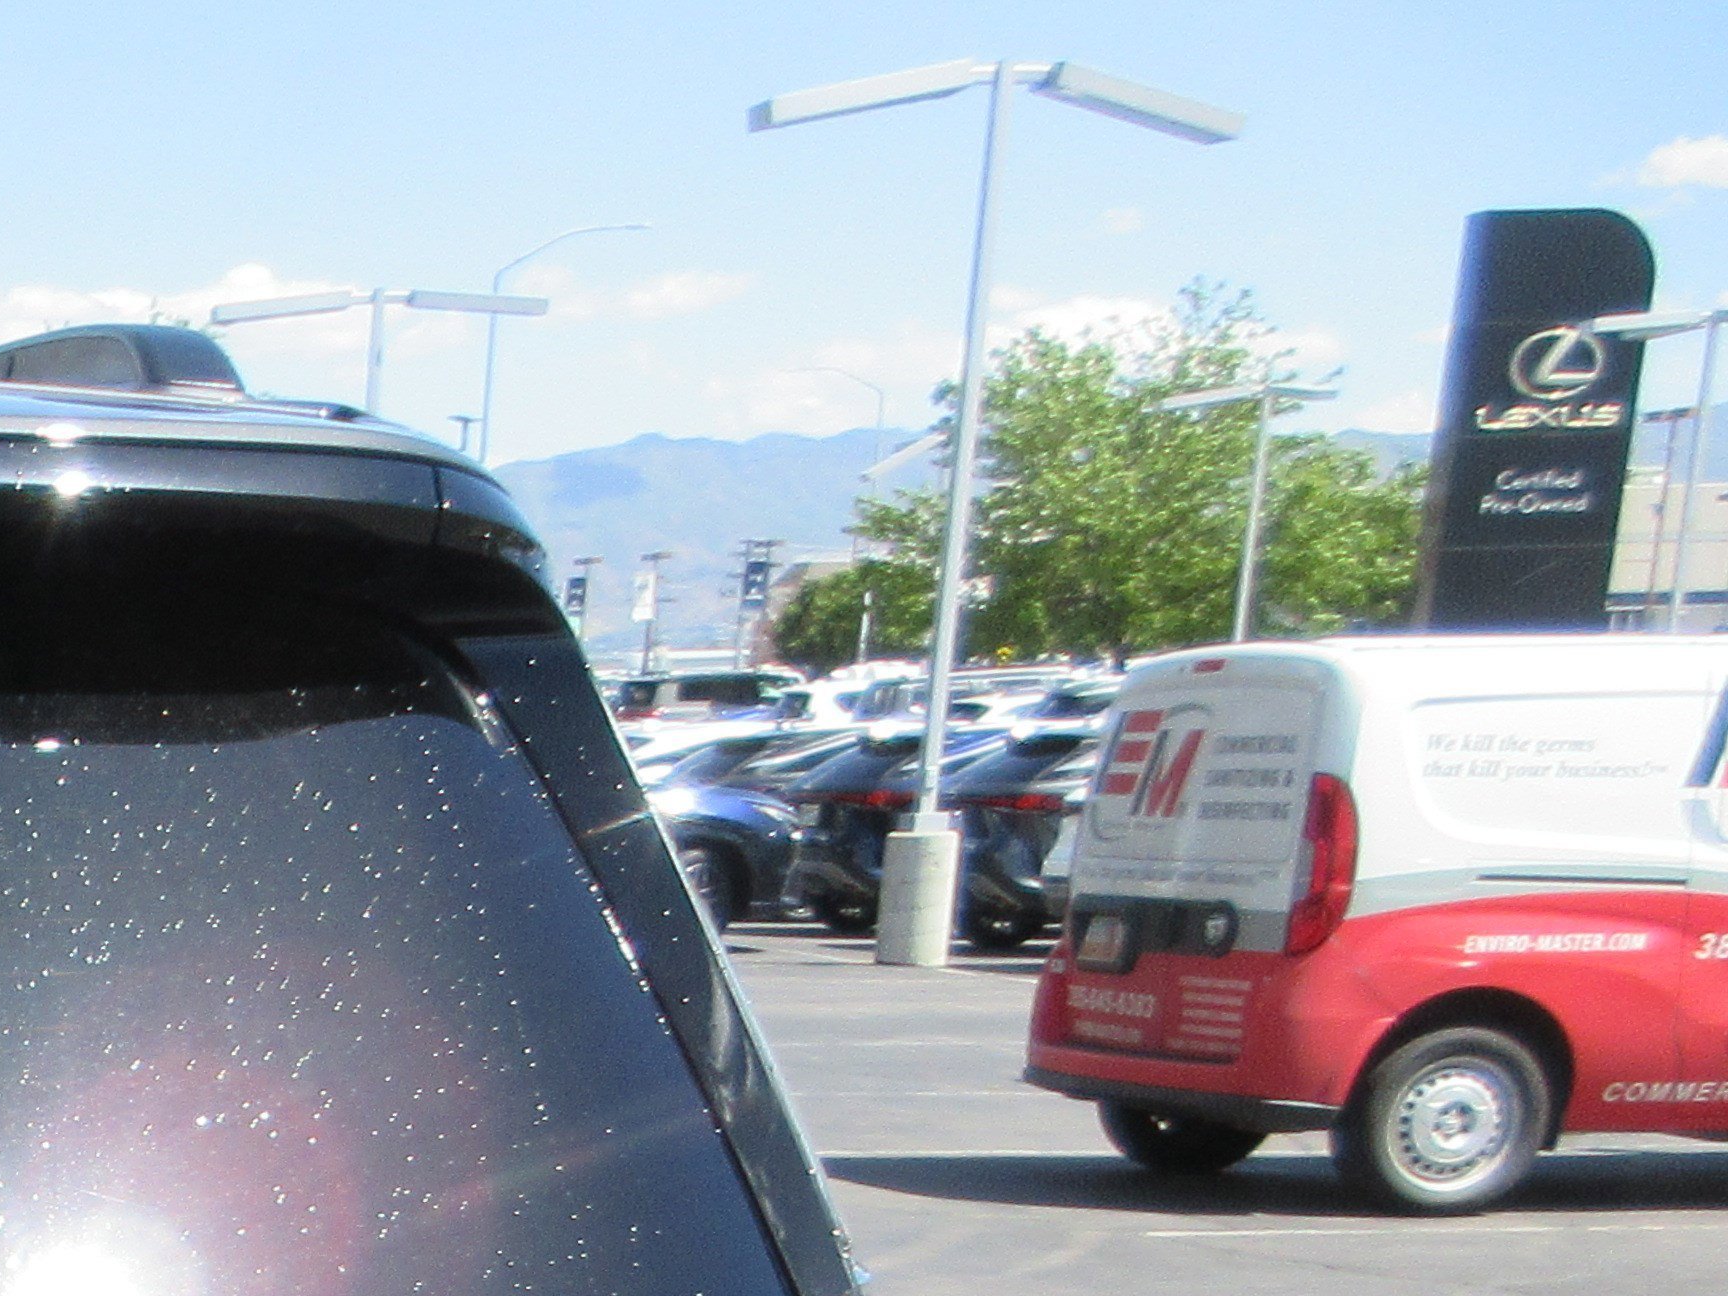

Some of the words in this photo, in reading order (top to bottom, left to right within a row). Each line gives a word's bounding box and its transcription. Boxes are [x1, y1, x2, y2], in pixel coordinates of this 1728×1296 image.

[1474, 403, 1624, 430] LEXUS
[1426, 734, 1452, 752] We
[1460, 733, 1496, 752] kill
[1499, 735, 1530, 752] the
[1535, 738, 1597, 757] germs
[1422, 761, 1463, 777] that
[1467, 760, 1502, 778] kill
[1504, 765, 1551, 782] your
